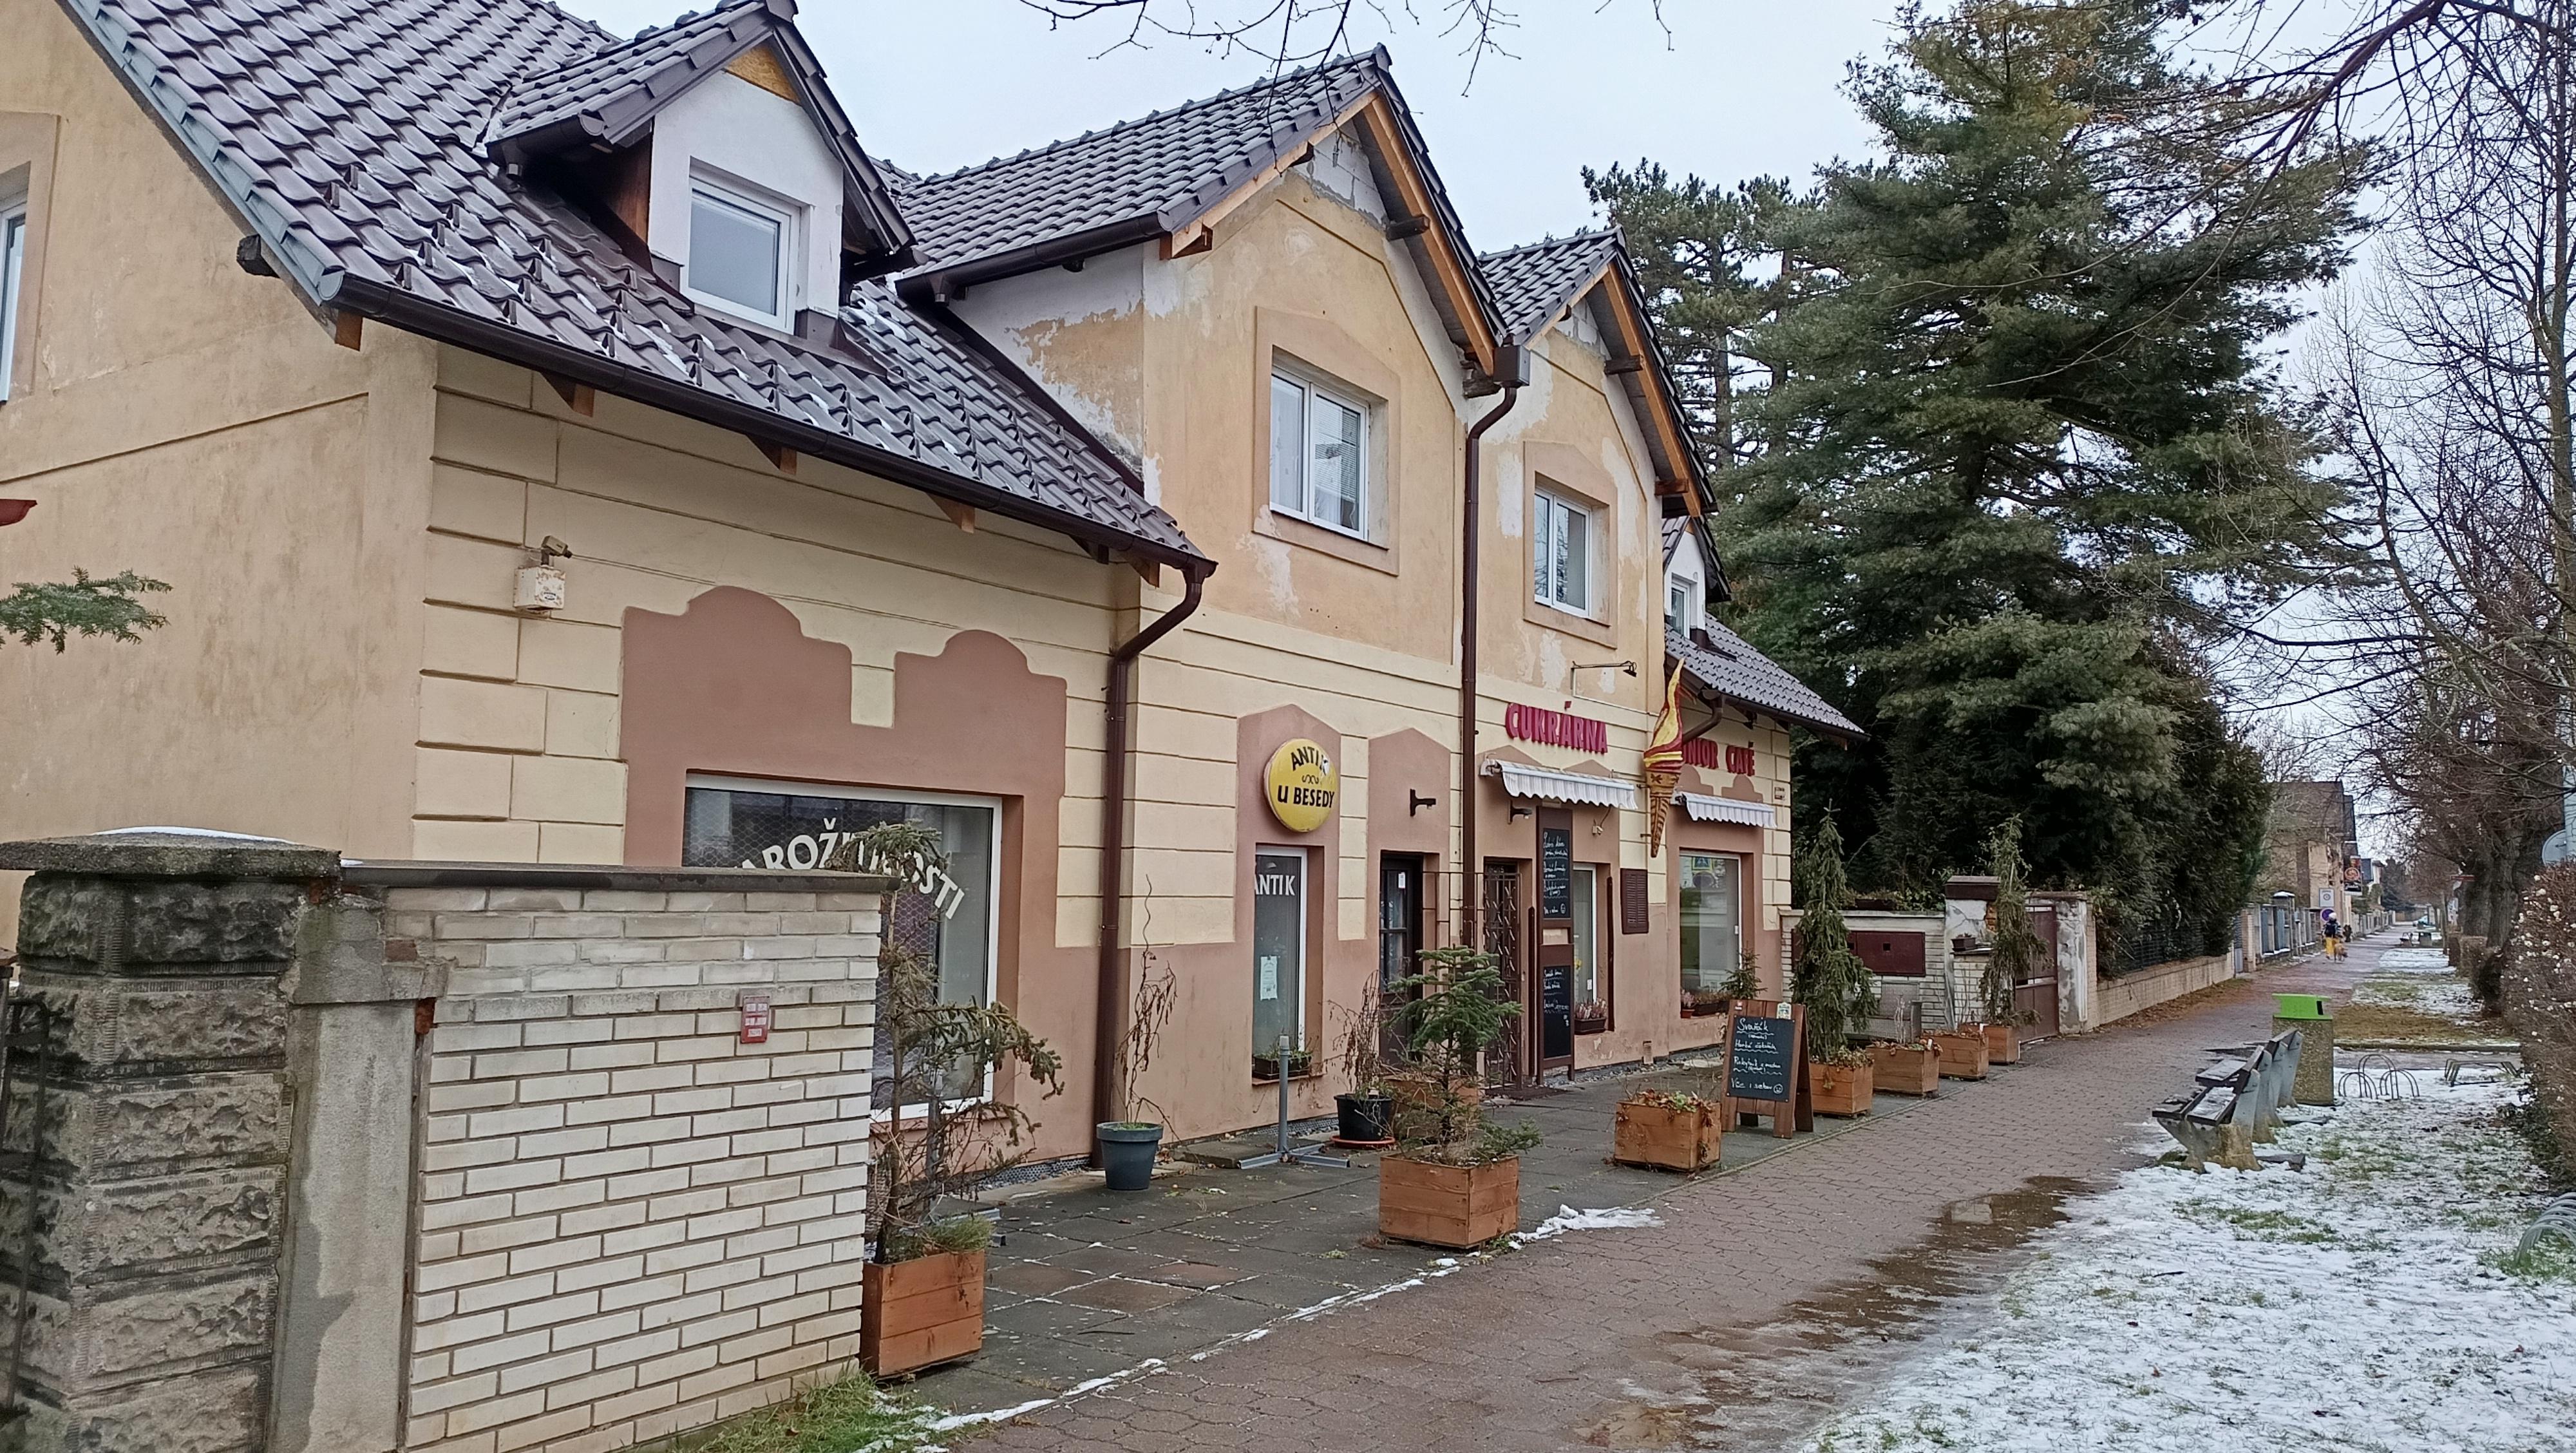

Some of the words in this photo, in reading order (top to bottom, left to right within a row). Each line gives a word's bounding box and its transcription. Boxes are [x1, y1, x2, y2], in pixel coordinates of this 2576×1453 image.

[1505, 701, 1608, 754] CUKRÁRNA
[1726, 741, 1756, 777] CAFÉ
[1278, 784, 1289, 803] U
[1293, 786, 1334, 808] BESEDY
